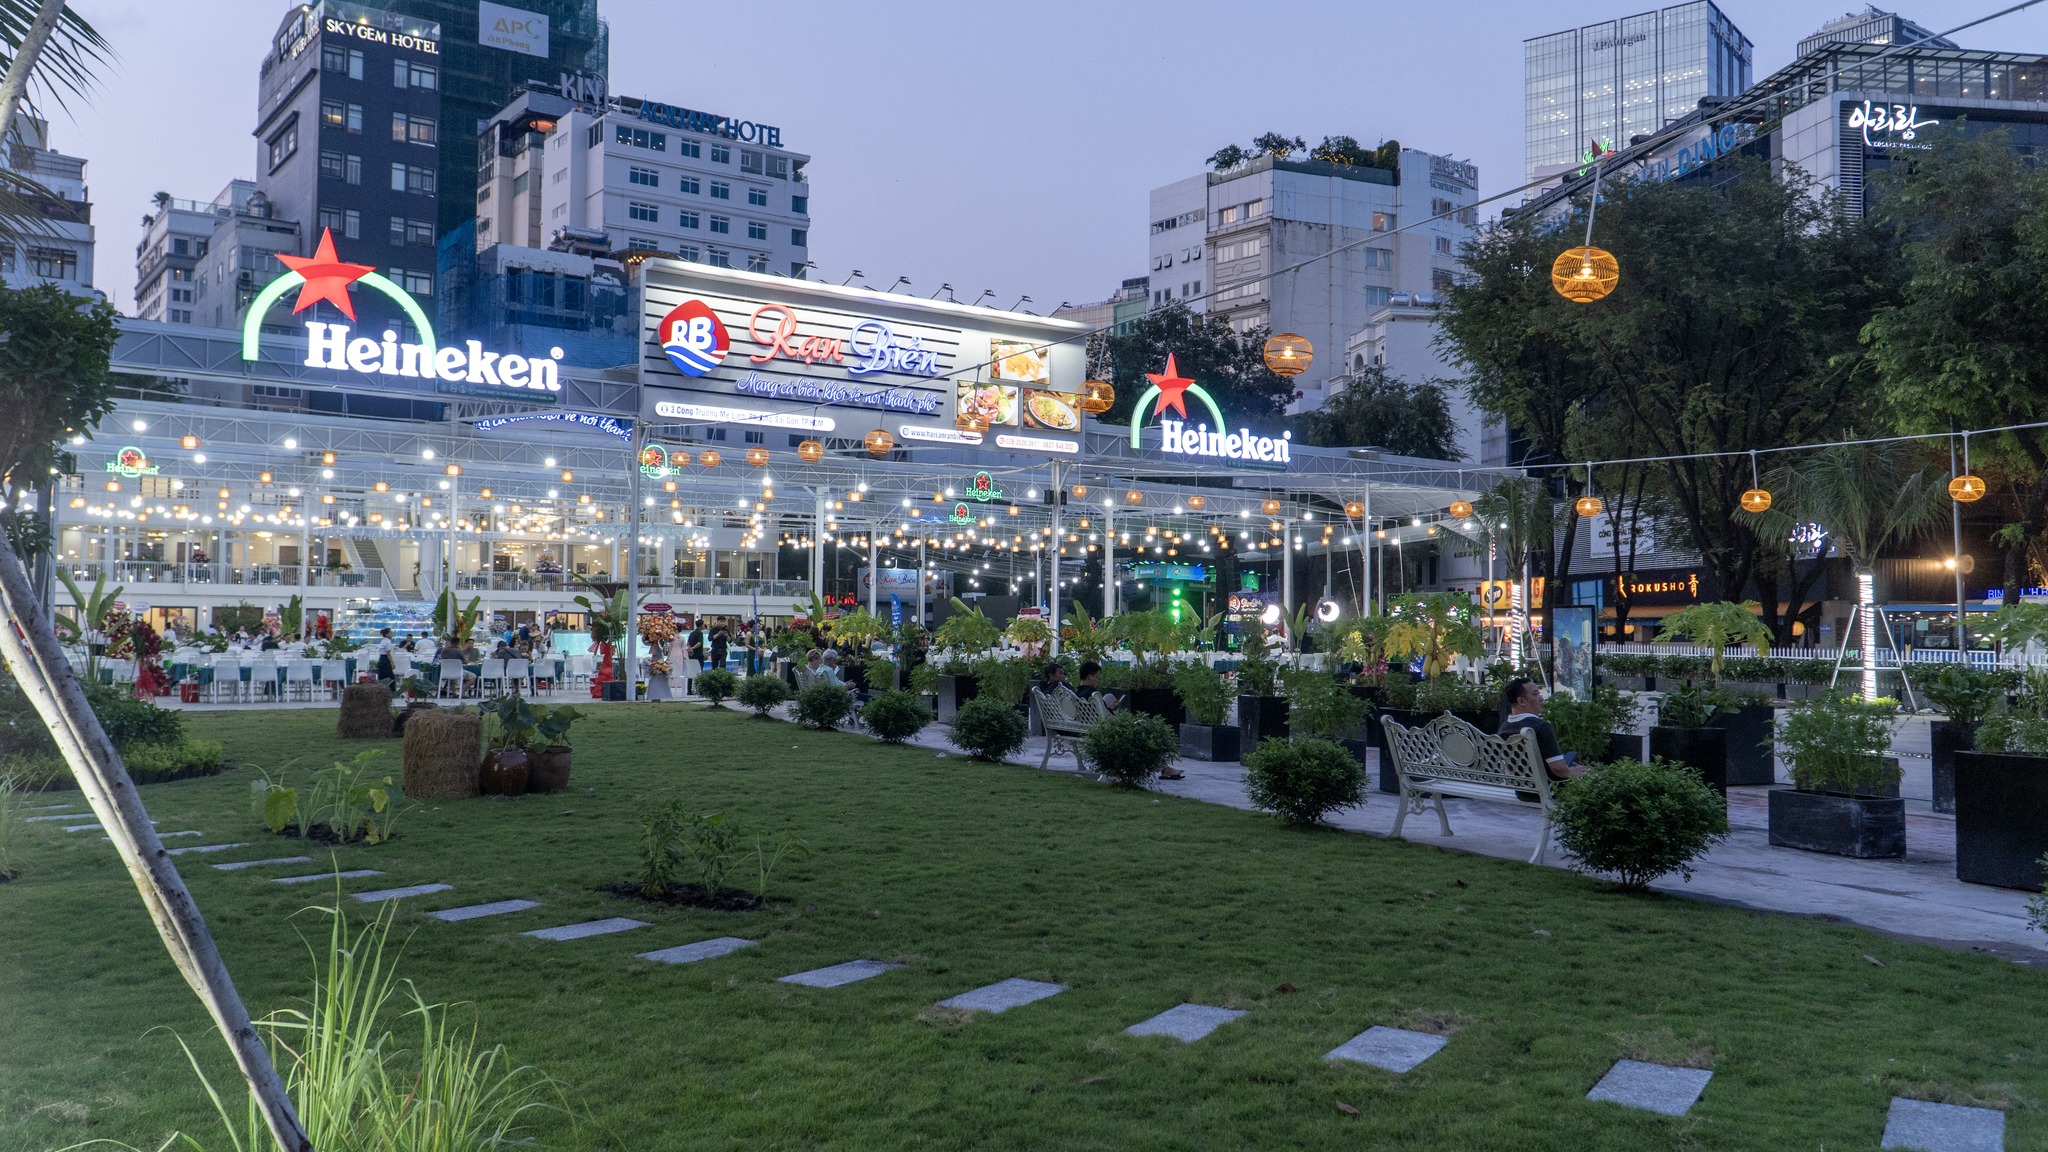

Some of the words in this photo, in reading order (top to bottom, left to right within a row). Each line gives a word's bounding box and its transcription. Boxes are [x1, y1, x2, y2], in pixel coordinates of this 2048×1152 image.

[326, 19, 388, 44] SKYGEM
[391, 33, 439, 55] HOTEL
[725, 117, 784, 148] HOTEL
[1848, 100, 1939, 146] 아리랑
[670, 316, 716, 351] RB
[848, 319, 940, 374] Biển
[304, 321, 562, 391] Heineken
[736, 371, 778, 397] Mang
[1161, 420, 1291, 462] Heineken
[966, 488, 1002, 498] Heineken
